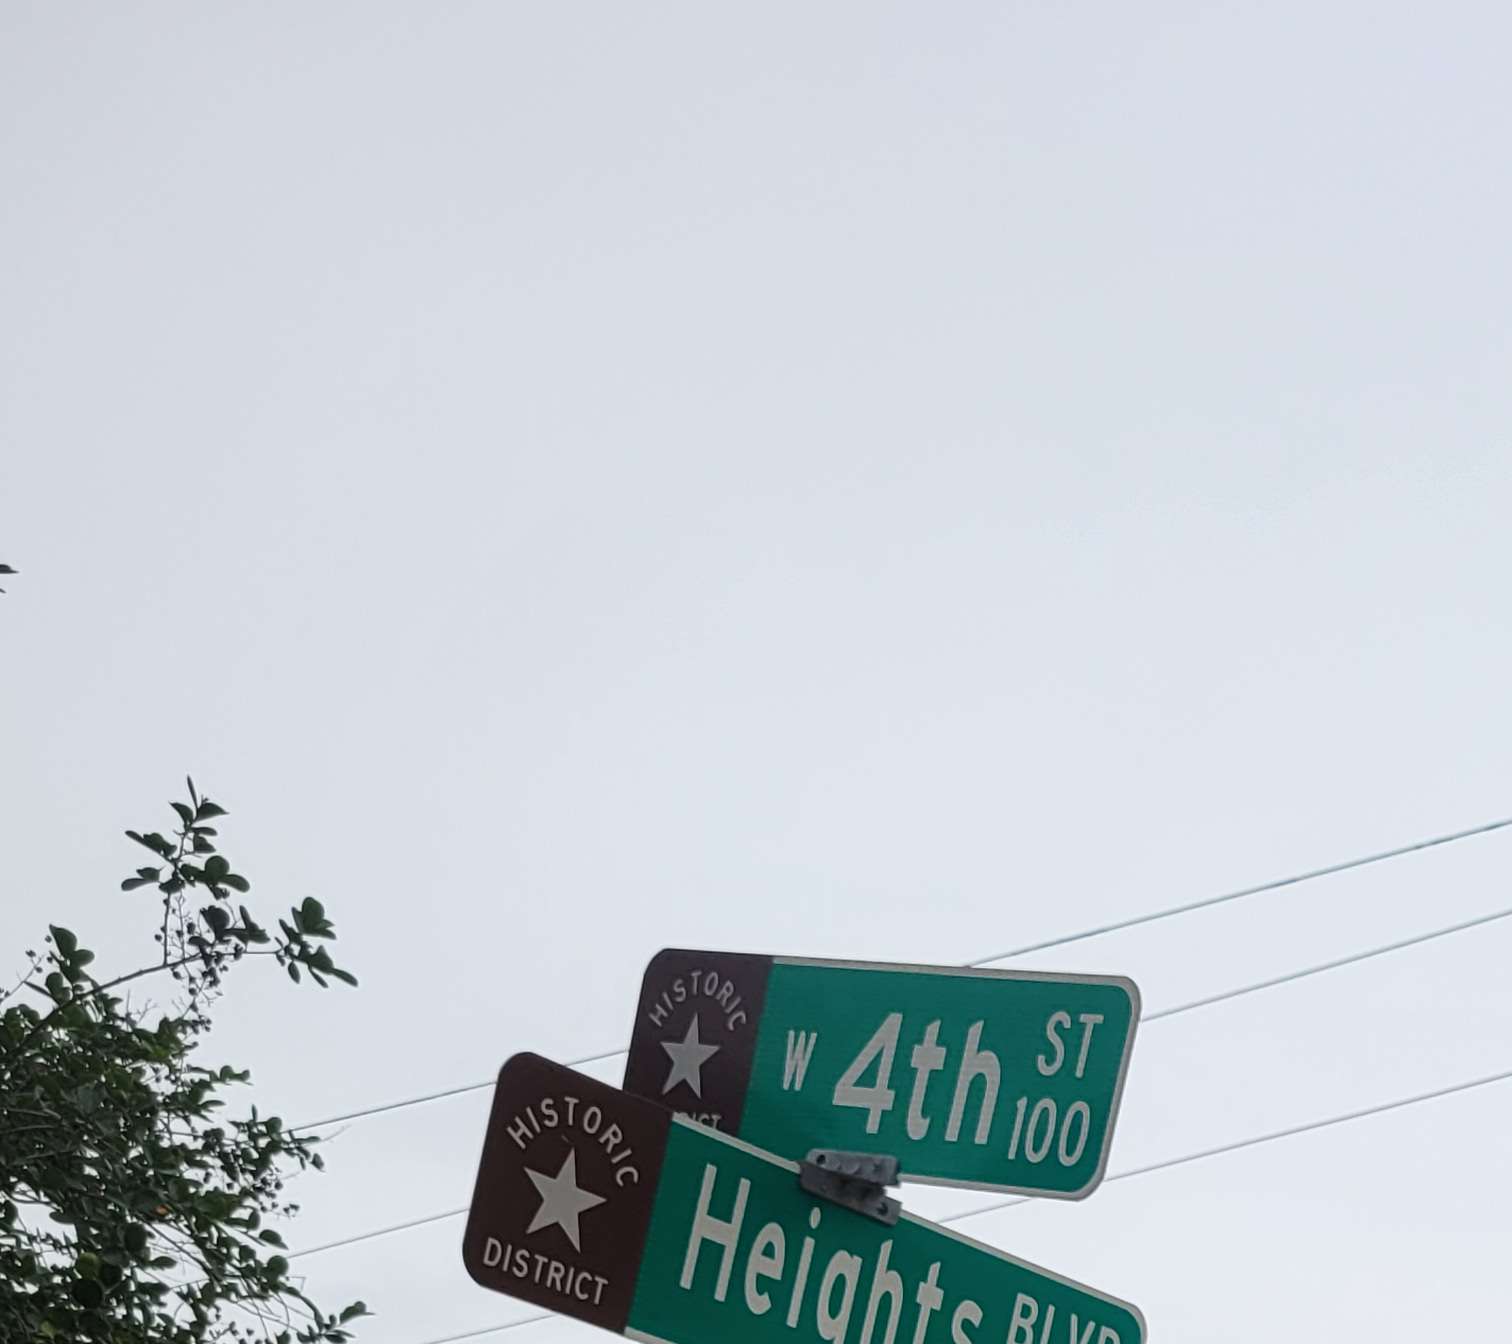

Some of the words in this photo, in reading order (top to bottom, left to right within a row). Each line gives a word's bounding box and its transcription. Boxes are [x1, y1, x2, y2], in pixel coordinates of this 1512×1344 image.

[648, 969, 747, 1032] HISTORIC
[783, 1030, 817, 1091] W
[832, 1012, 1001, 1145] 4th
[1037, 1011, 1104, 1078] ST
[506, 1096, 639, 1187] HISTORIC
[1008, 1096, 1091, 1168] 100
[483, 1236, 608, 1305] DISTRICT
